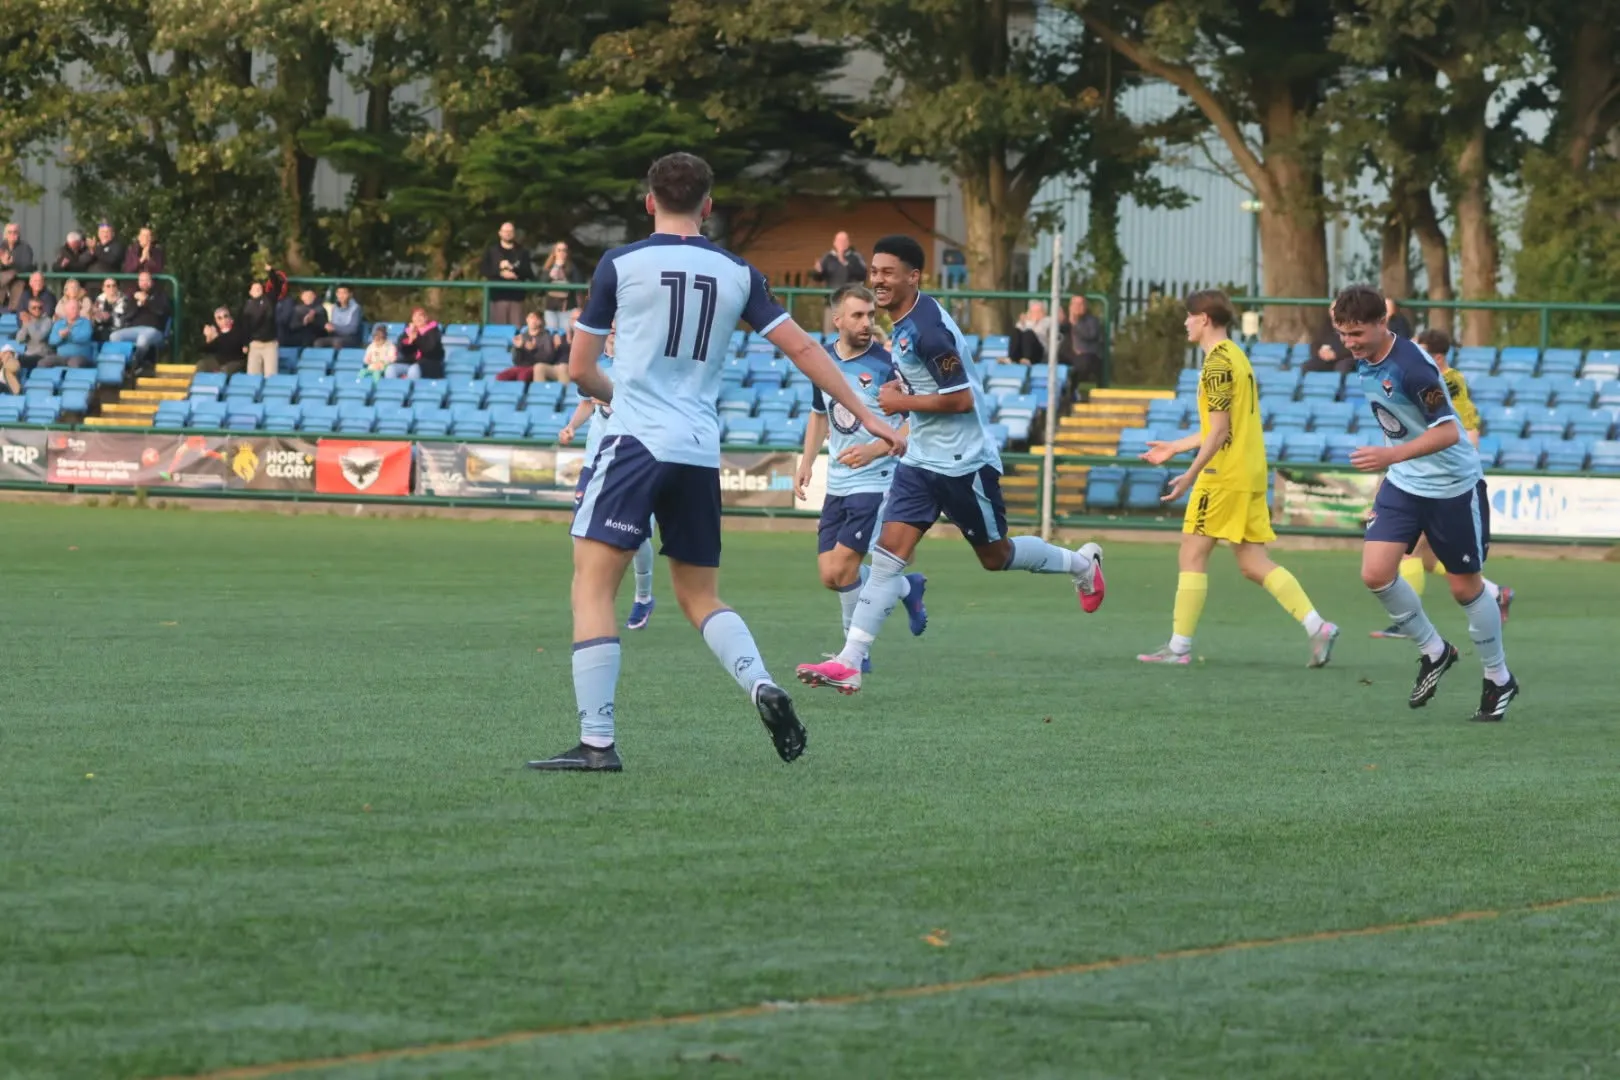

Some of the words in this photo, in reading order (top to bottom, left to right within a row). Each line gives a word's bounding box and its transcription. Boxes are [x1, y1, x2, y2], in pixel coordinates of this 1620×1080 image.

[660, 271, 718, 362] 11
[2, 445, 39, 464] FRP
[266, 451, 304, 464] HOPE
[266, 464, 313, 478] GLORY
[720, 468, 793, 491] icles.im
